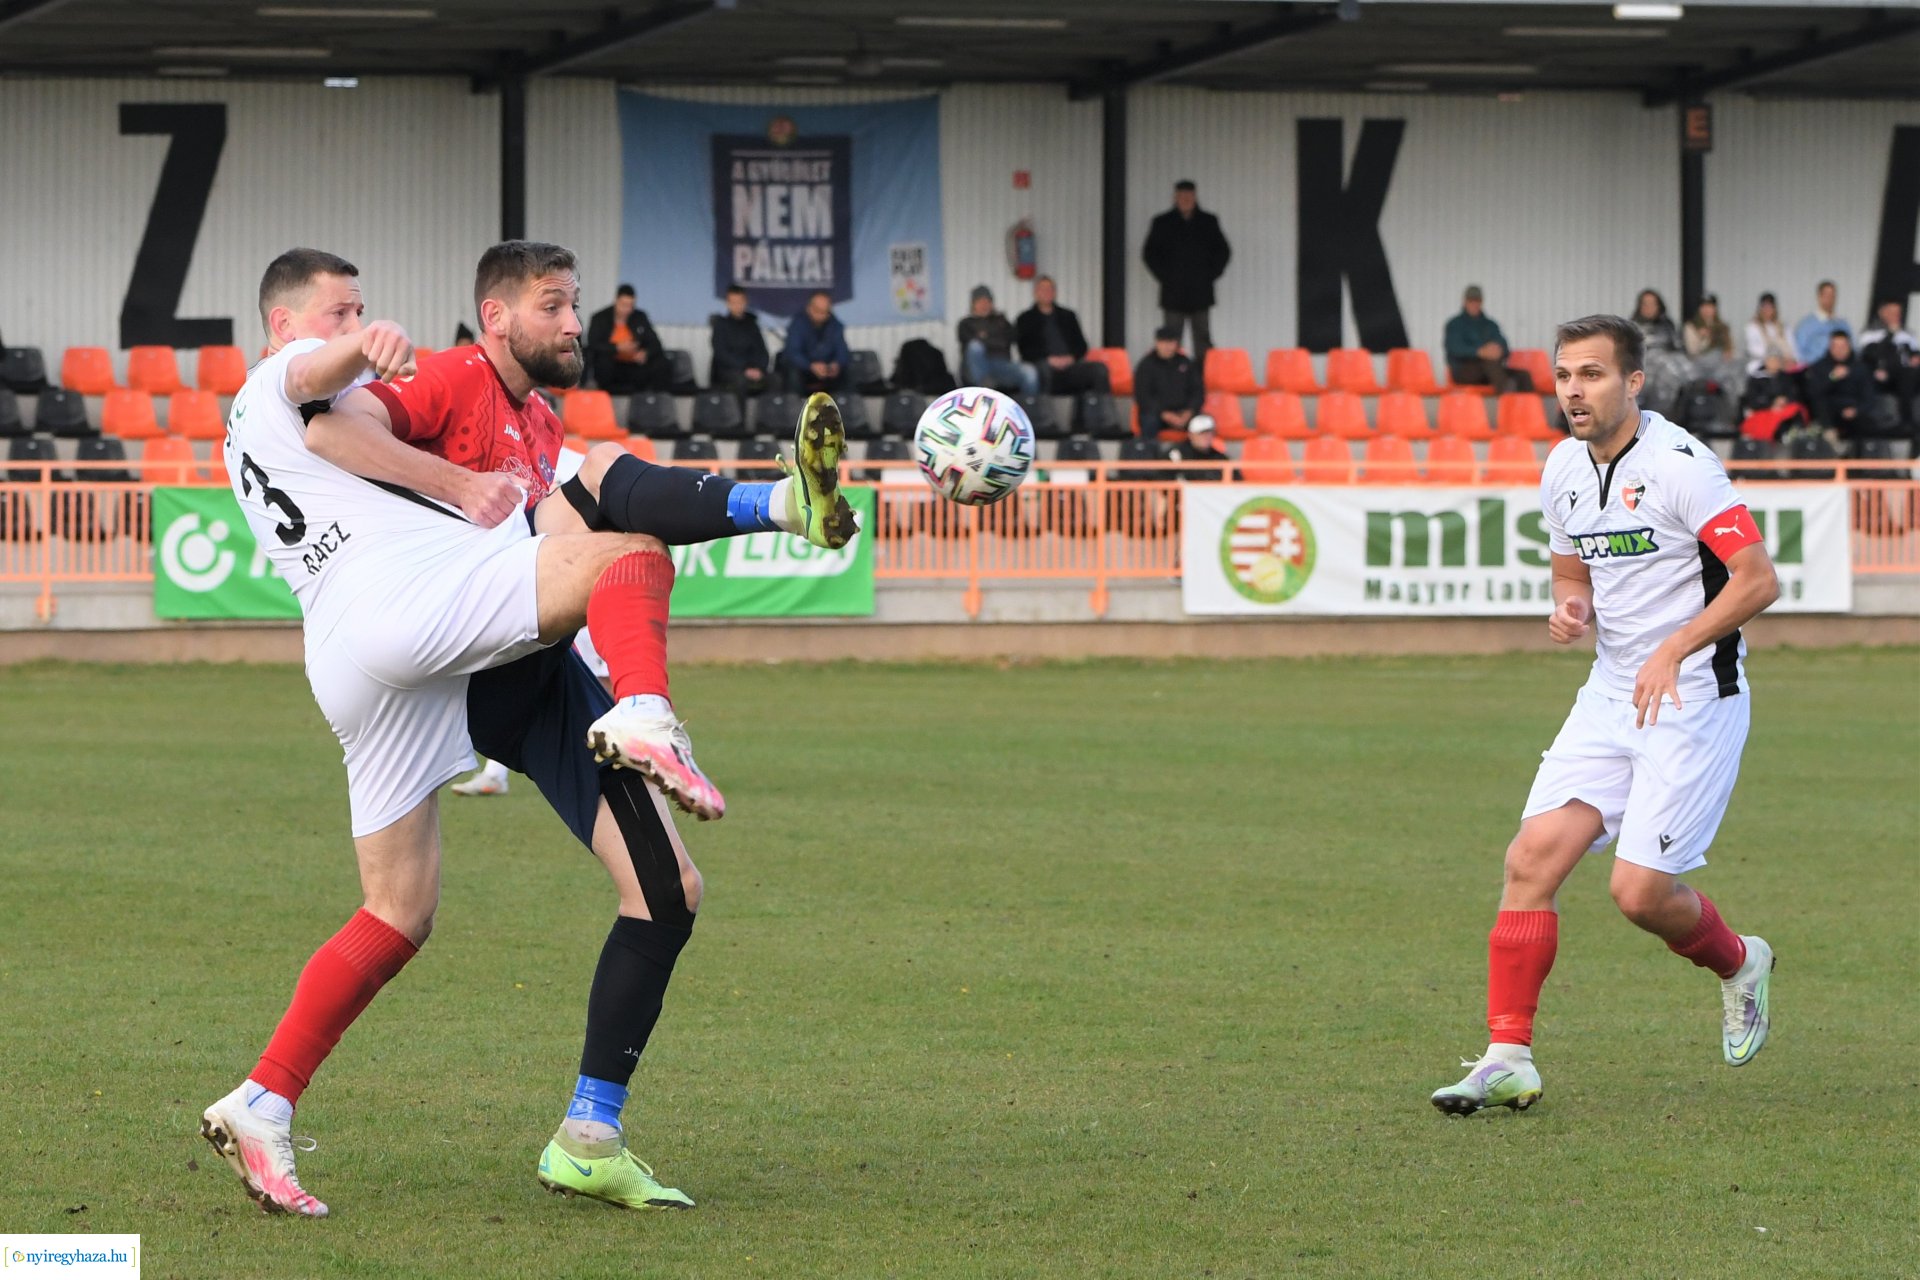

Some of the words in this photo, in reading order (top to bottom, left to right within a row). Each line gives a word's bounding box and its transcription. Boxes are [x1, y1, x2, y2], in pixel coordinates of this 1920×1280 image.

[119, 102, 233, 348] Z
[732, 184, 832, 237] NEM
[1297, 119, 1408, 352] K
[734, 240, 833, 281] PÁLYA!
[1365, 578, 1470, 605] Magyar
